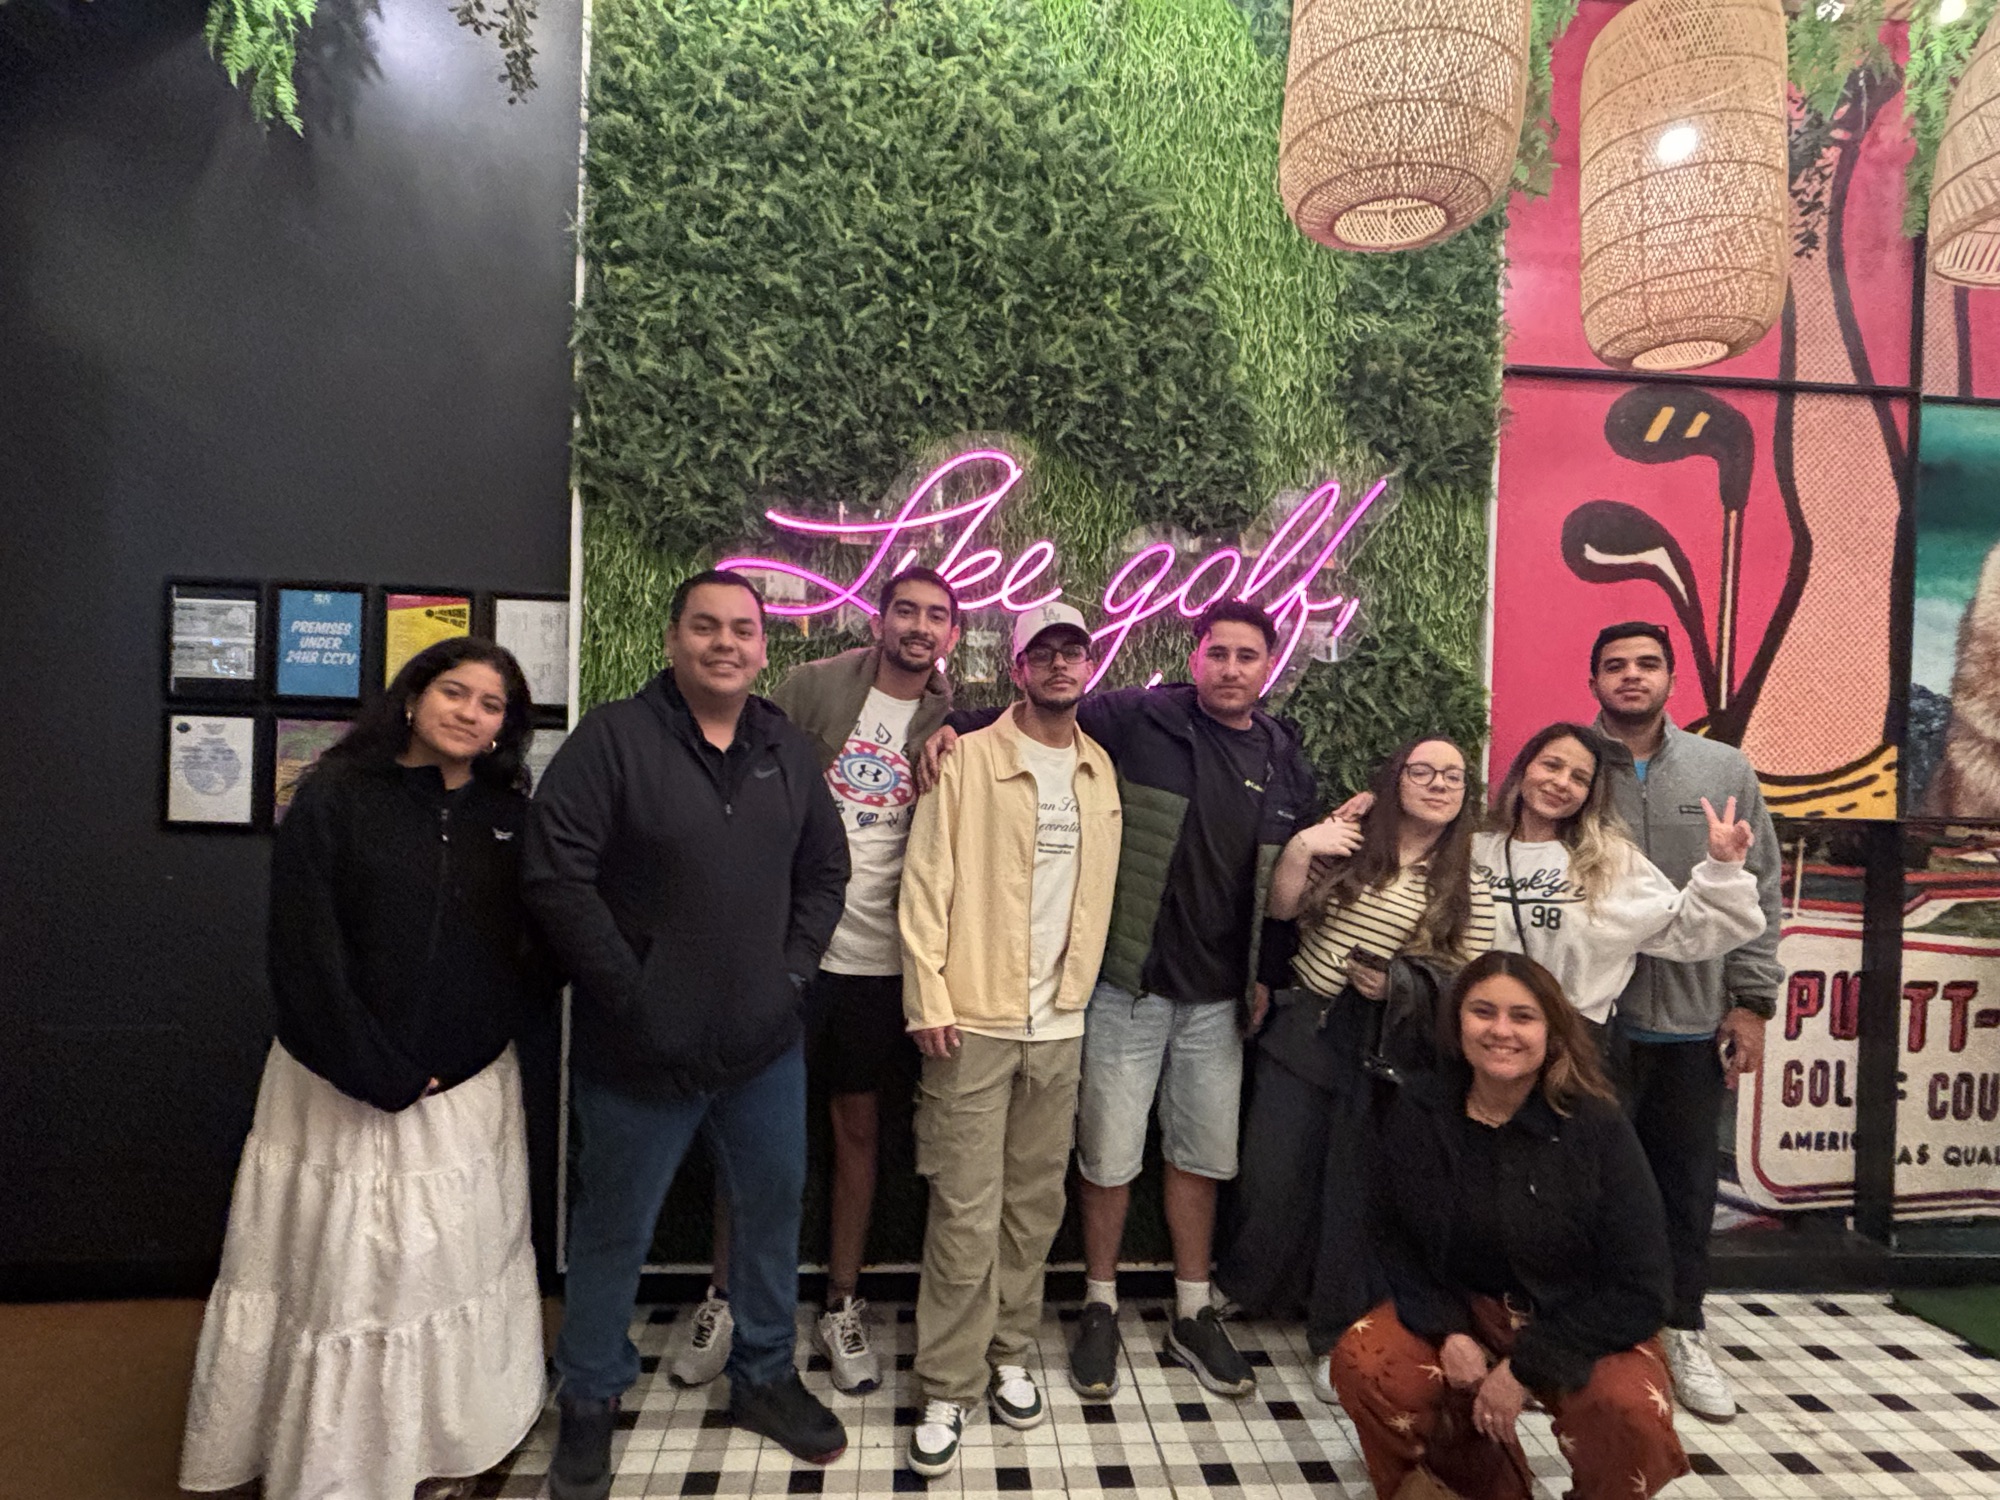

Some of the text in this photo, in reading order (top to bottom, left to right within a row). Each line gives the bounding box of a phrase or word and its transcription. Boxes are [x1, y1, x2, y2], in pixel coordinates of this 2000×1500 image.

[1041, 605, 1061, 622] LA
[291, 620, 353, 637] PREMISES
[299, 635, 343, 650] UNDER
[285, 649, 357, 666] 24HR CCTV
[1037, 802, 1055, 810] an
[1531, 905, 1562, 931] 98
